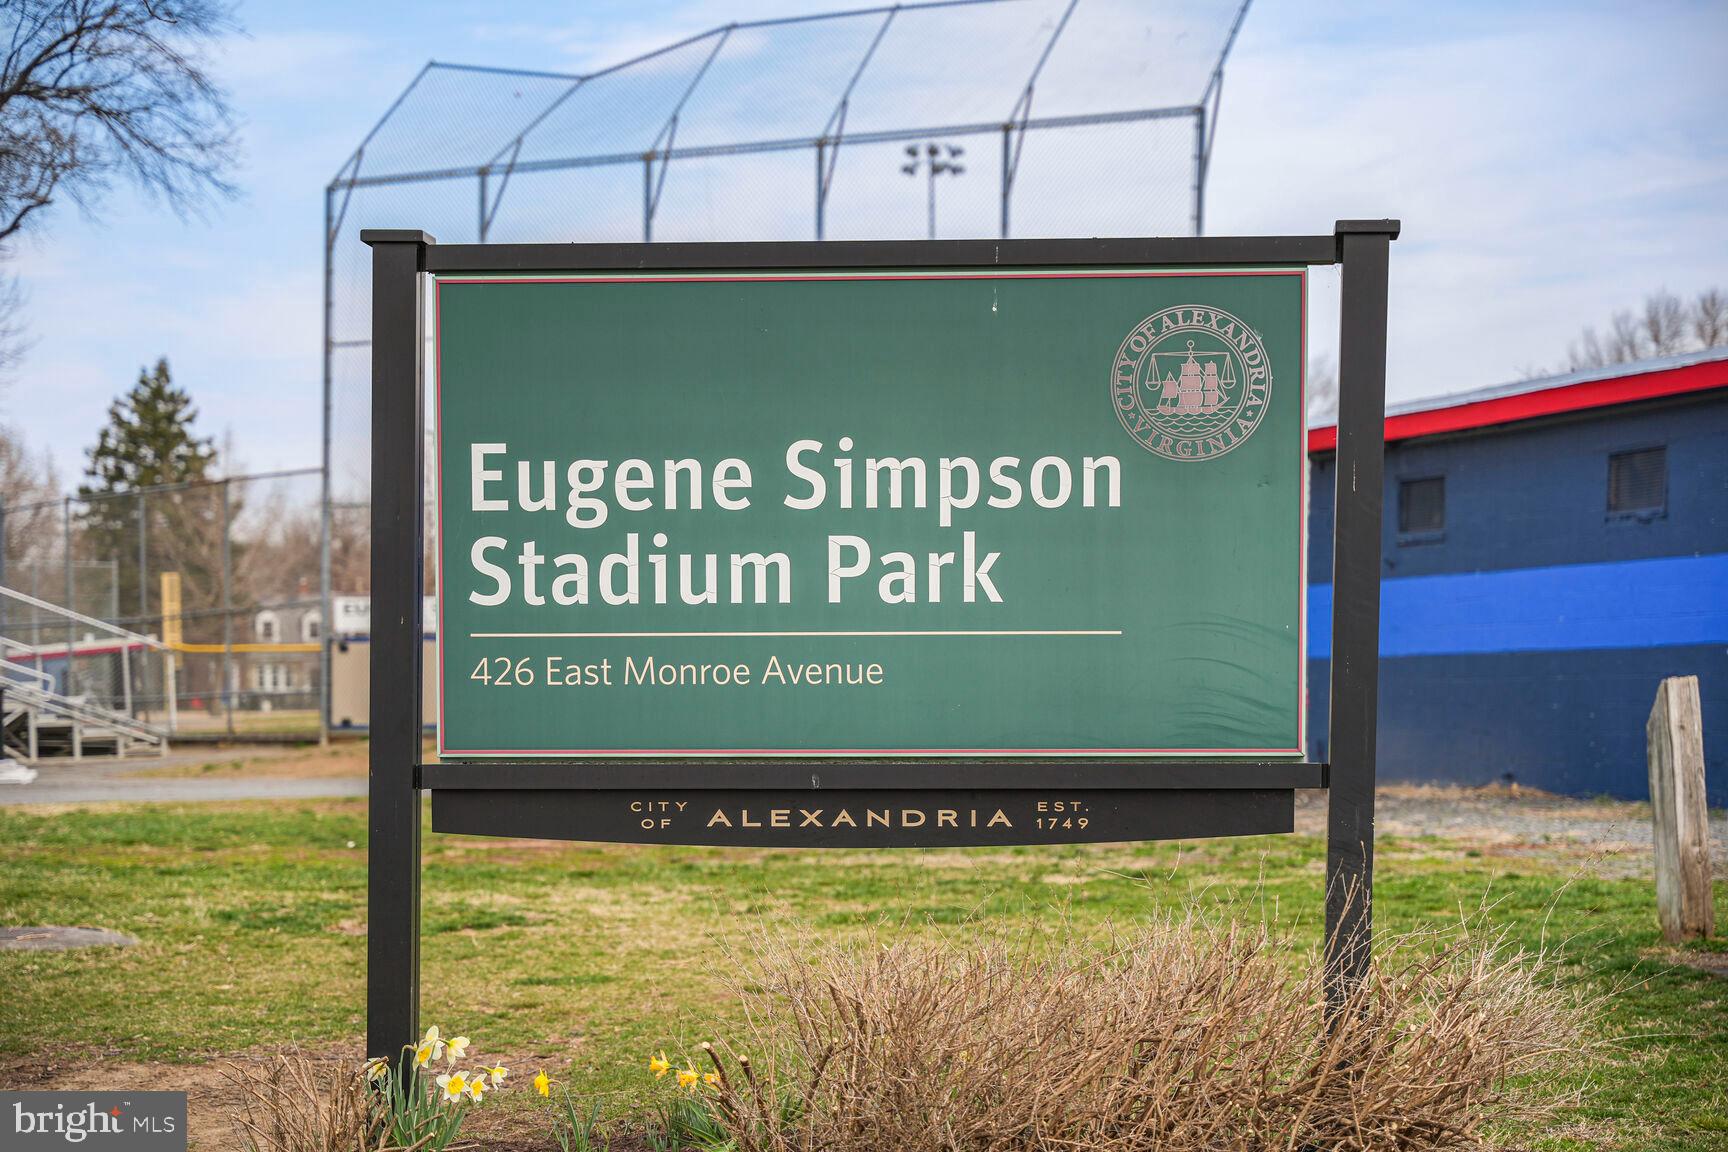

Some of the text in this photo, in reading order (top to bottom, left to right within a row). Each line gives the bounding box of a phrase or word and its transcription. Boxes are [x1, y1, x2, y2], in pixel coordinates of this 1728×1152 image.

[1116, 309, 1267, 411] CITY OF ALEXANDRIA
[1133, 415, 1254, 457] VIRGINIA
[470, 436, 1121, 529] Eugene Simpson
[469, 530, 1004, 607] Stadium Park
[470, 655, 884, 686] 426 East Monroe Avenue
[630, 801, 688, 812] CITY
[706, 808, 1013, 828] ALEXANDRIA
[1037, 801, 1090, 812] EST.
[641, 818, 672, 829] OF
[1036, 817, 1089, 830] 1749
